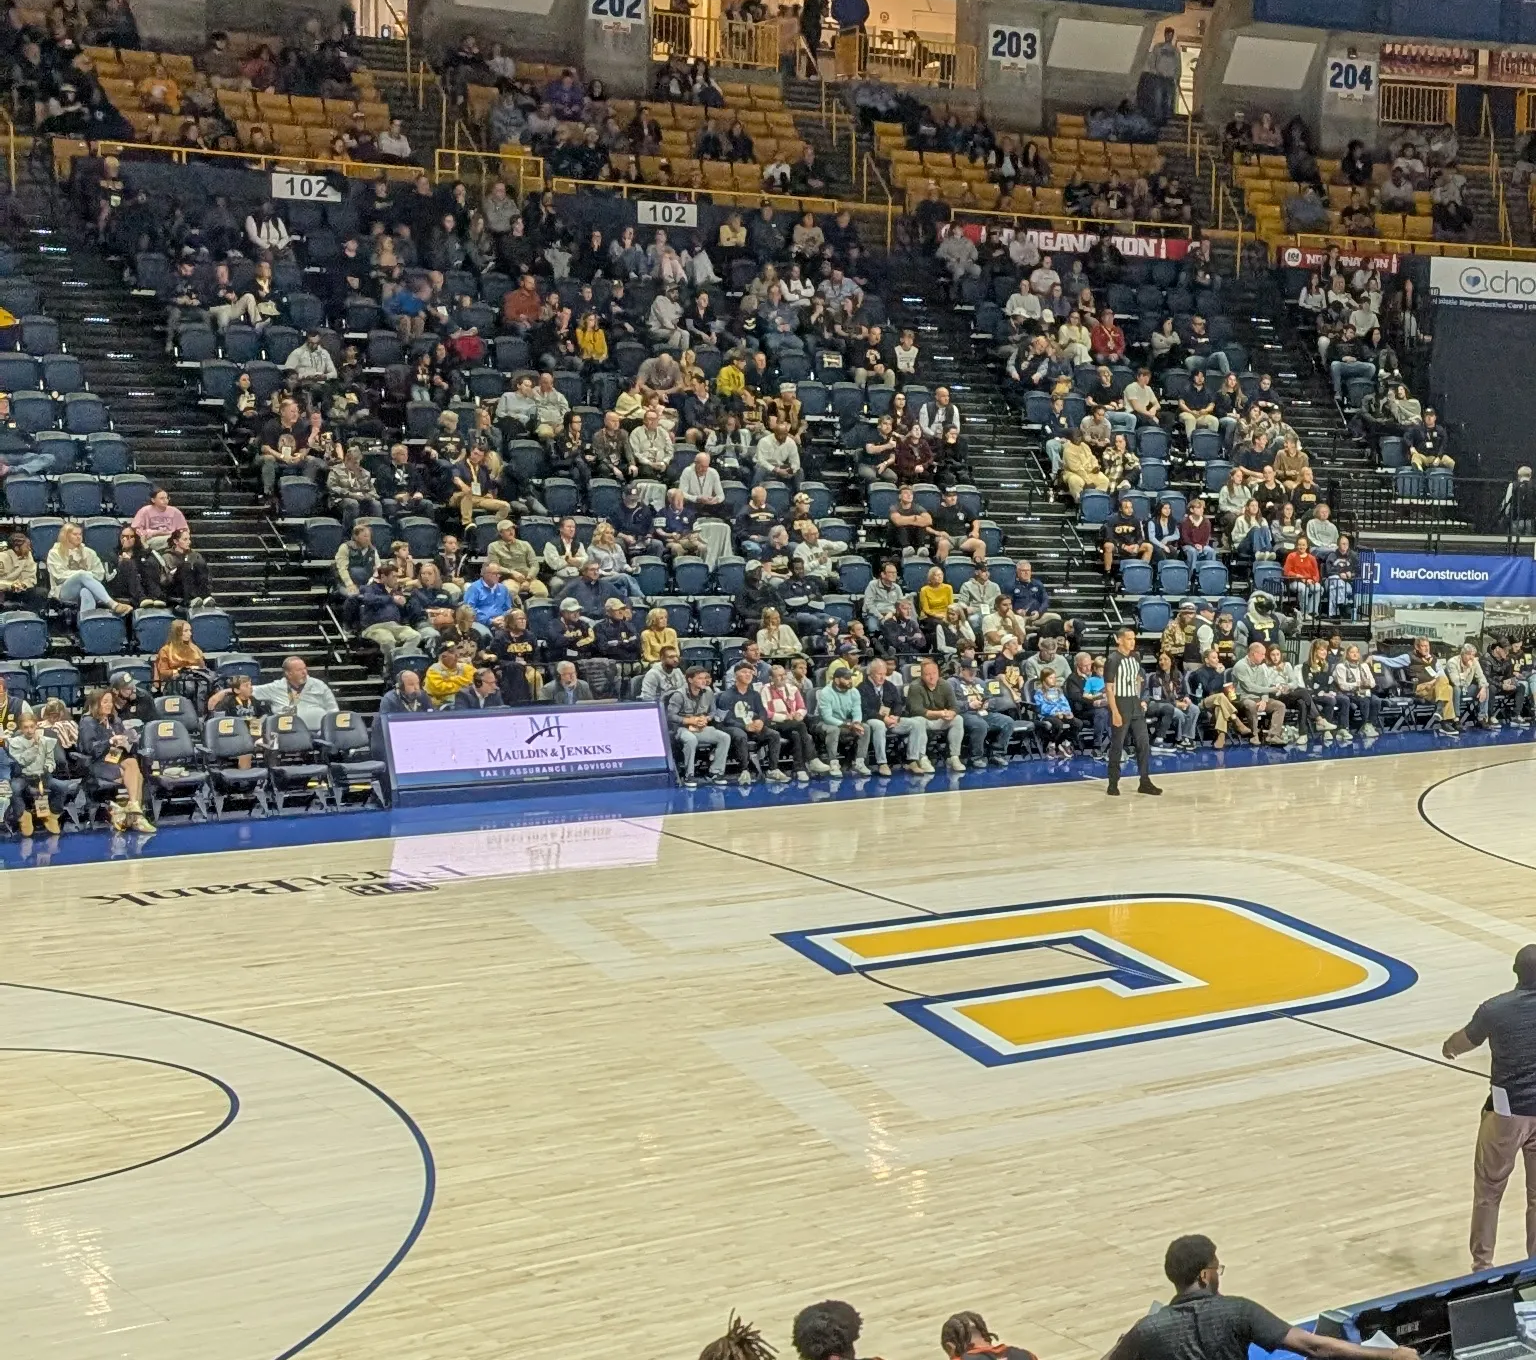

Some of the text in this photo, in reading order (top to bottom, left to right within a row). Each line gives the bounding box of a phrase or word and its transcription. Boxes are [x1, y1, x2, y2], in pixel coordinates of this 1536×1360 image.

[992, 29, 1038, 61] 203
[1329, 60, 1373, 92] 204
[284, 176, 328, 198] 102
[648, 203, 686, 225] 102
[480, 761, 624, 778] TAX ASSURANCE ADVISORY
[770, 893, 1419, 1068] C
